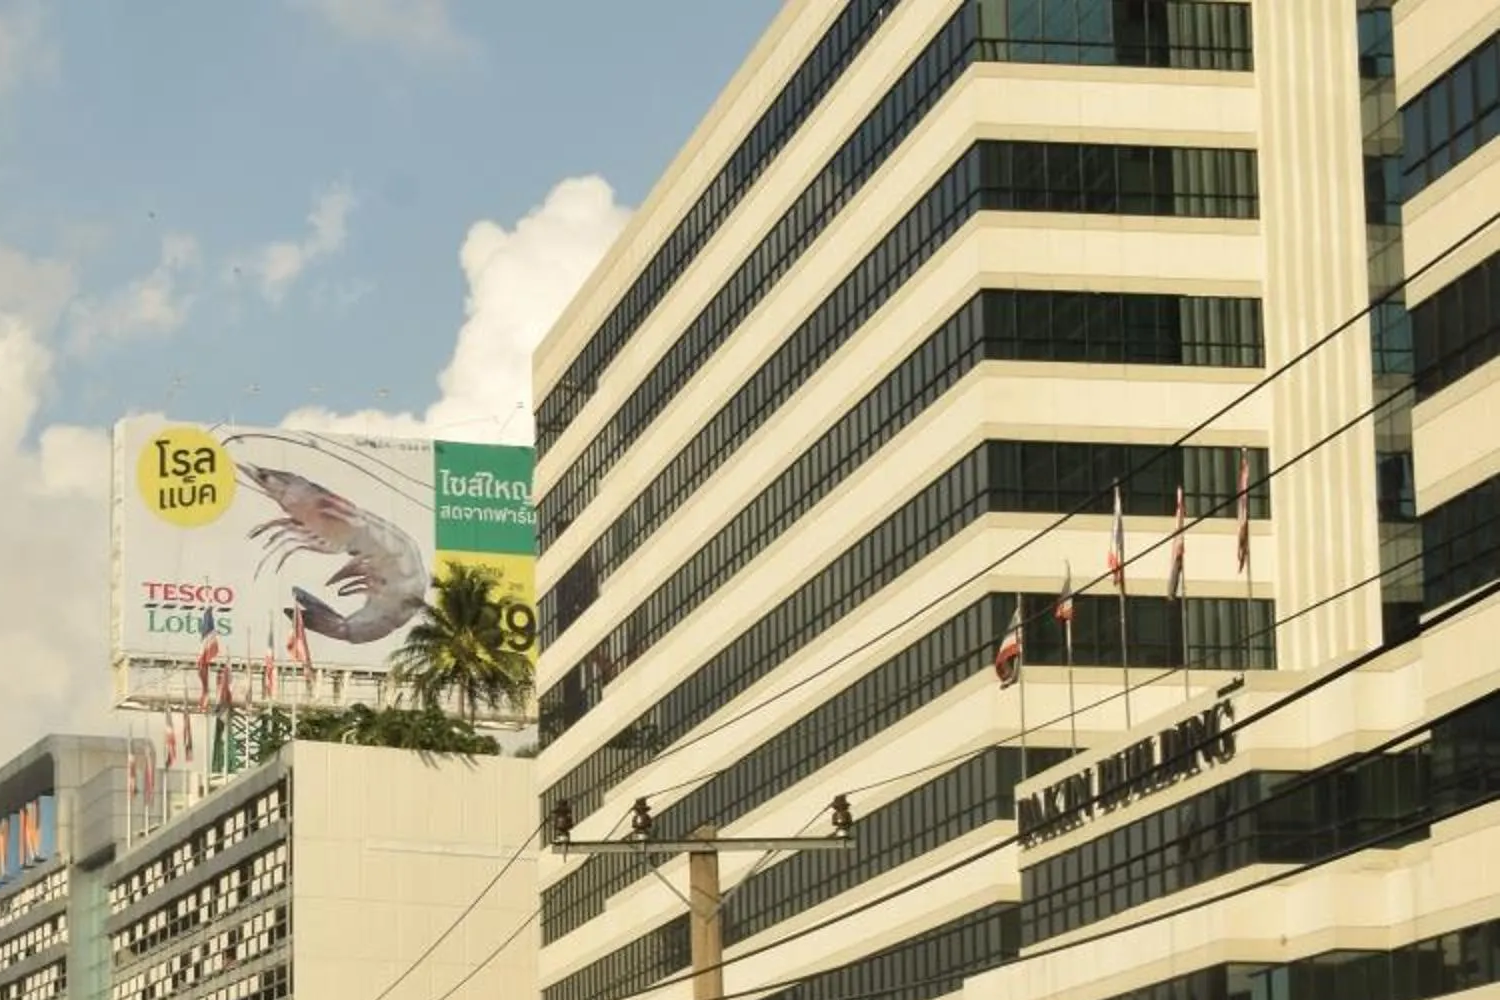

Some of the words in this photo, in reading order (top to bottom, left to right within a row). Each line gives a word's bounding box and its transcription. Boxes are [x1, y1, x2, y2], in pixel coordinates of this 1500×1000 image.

[155, 440, 216, 478] โรล
[159, 476, 216, 510] แบ็ค
[142, 583, 233, 605] TESCO
